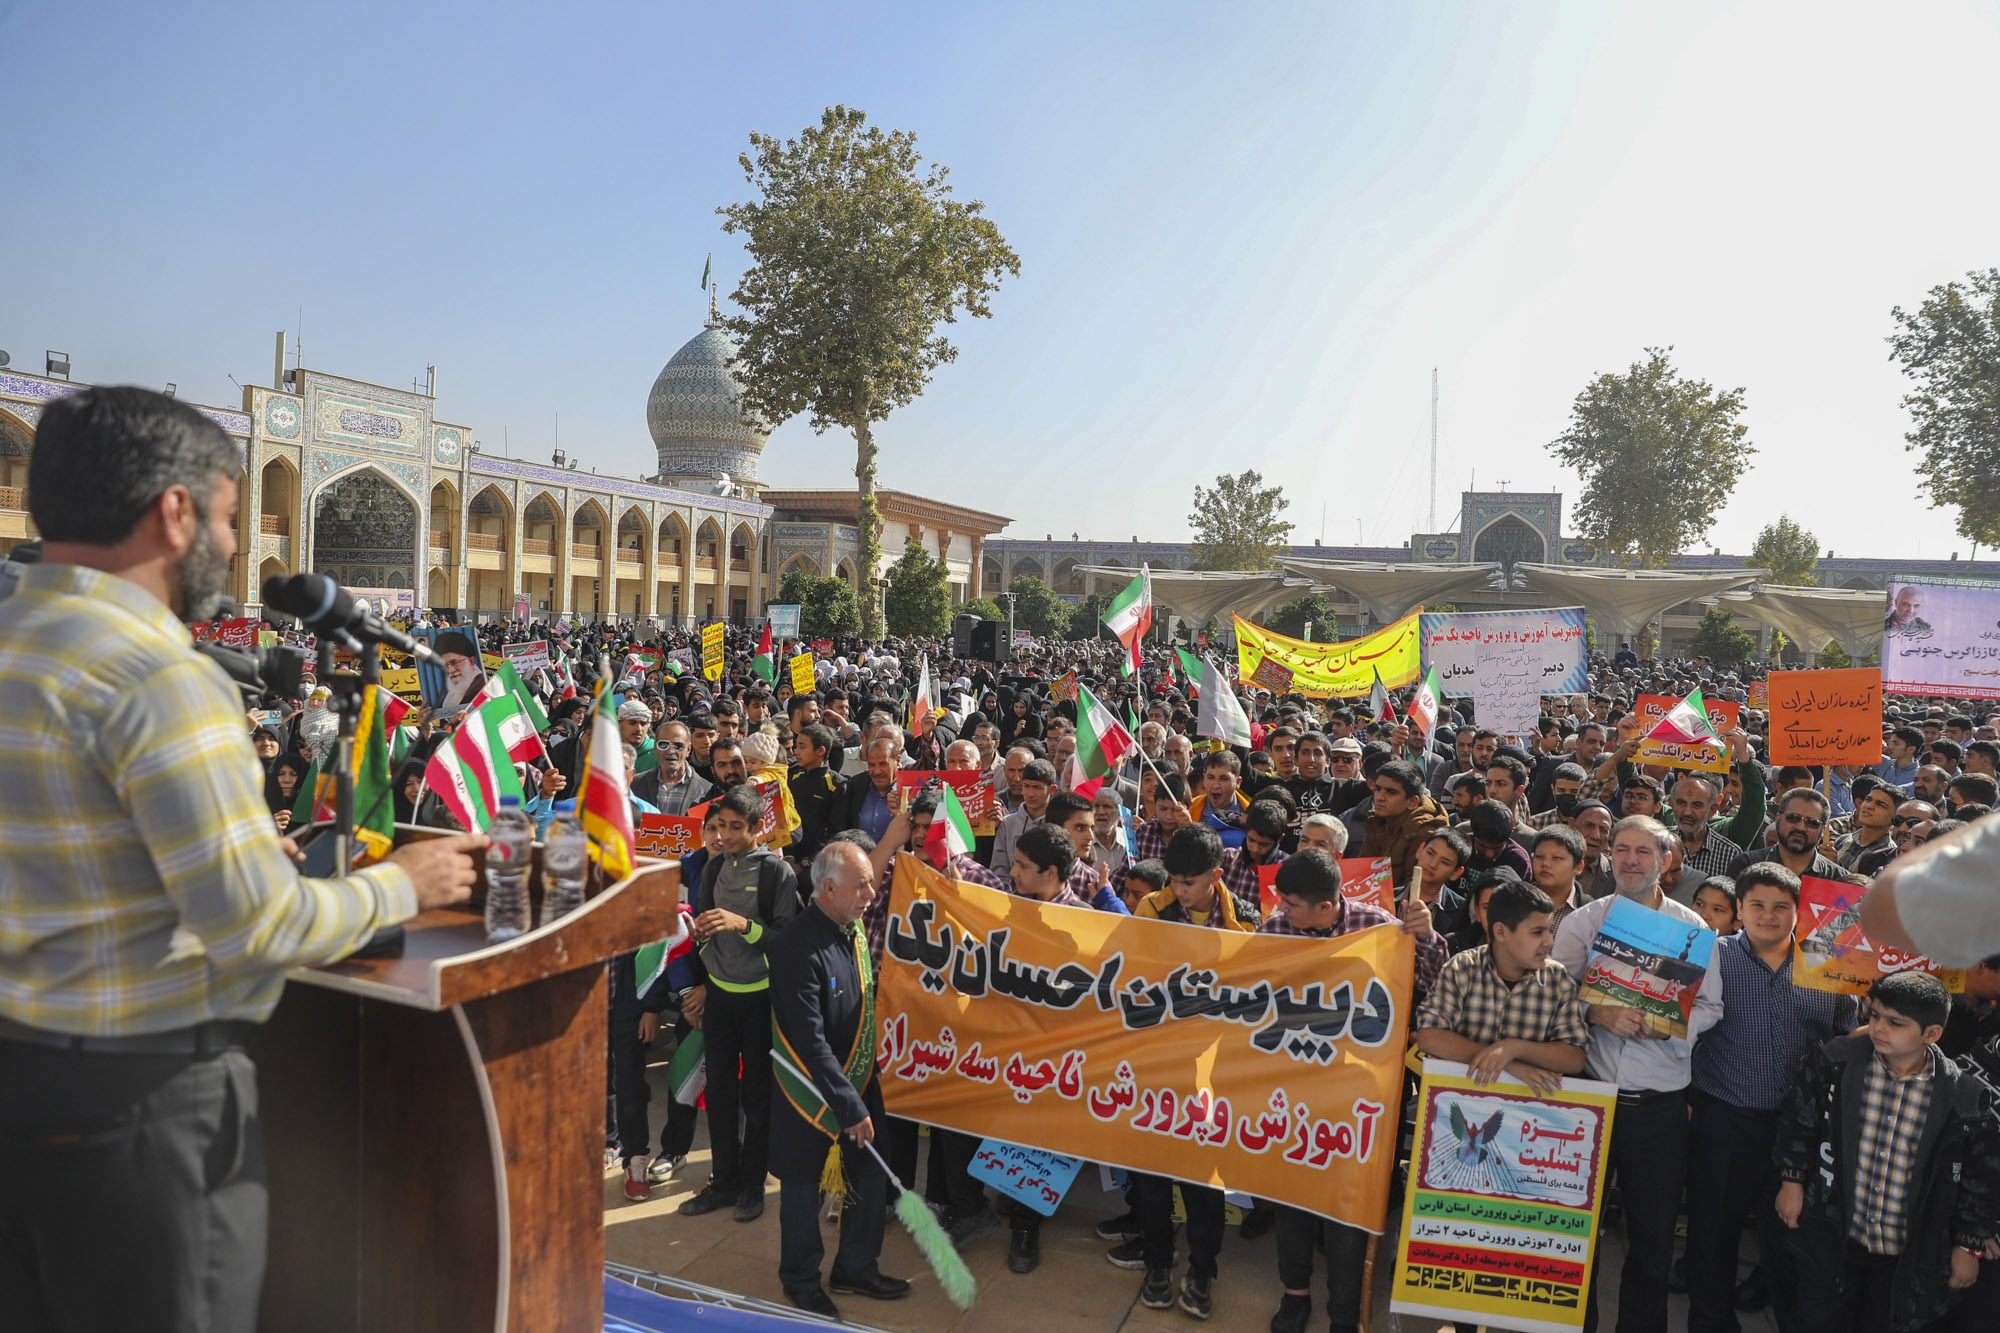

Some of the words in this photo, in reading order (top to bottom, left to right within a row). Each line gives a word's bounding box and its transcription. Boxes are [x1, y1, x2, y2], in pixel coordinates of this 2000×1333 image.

[1423, 626, 1445, 647] شیراز
[1446, 627, 1459, 645] یک
[1461, 625, 1481, 645] ناحیه
[1483, 625, 1512, 645] پرورش
[1519, 621, 1549, 645] آموزش
[1551, 626, 1583, 642] مدیریت
[1299, 646, 1328, 674] شهید
[1899, 646, 1942, 658] جنوبی
[1781, 690, 1816, 712] ایران
[1817, 693, 1848, 710] سازان
[1849, 685, 1876, 711] آینده
[1815, 729, 1843, 748] تمدن
[1837, 734, 1871, 750] معماران
[1693, 748, 1717, 764] مرگ
[667, 824, 691, 840] مرگ
[886, 900, 953, 995] یک
[952, 927, 1125, 1011] احسان
[1637, 955, 1663, 970] آزاد
[1585, 958, 1681, 1003] فلسطین
[1823, 969, 1842, 980] کنید
[1842, 972, 1870, 986] متوقف
[1117, 962, 1394, 1066] دبیرستان
[877, 1013, 957, 1083] شیراز
[956, 1042, 999, 1084] سه
[1003, 1050, 1086, 1104] ناحیه
[1236, 1087, 1385, 1171] آموزش
[1520, 1117, 1586, 1145] غزه
[1518, 1148, 1583, 1175] تسلیت
[1516, 1174, 1548, 1186] فلسطین
[1547, 1179, 1562, 1189] برای
[1014, 1174, 1060, 1206] آمریکا
[1419, 1199, 1444, 1211] فارس
[1445, 1203, 1470, 1214] استان
[1508, 1210, 1543, 1224] آموزش
[1544, 1213, 1559, 1226] کل
[1560, 1218, 1585, 1230] اداره
[1415, 1223, 1441, 1236] شیراز
[1443, 1225, 1450, 1234] ۲
[1452, 1227, 1476, 1239] ناحیه
[1518, 1237, 1554, 1250] آموزش
[1556, 1242, 1582, 1254] اداره
[1461, 1254, 1478, 1266] اول
[1479, 1256, 1511, 1269] متوسطه
[1513, 1260, 1540, 1273] پسرانه
[1541, 1263, 1581, 1279] دبیرستان
[1473, 1272, 1580, 1309] حمایت
